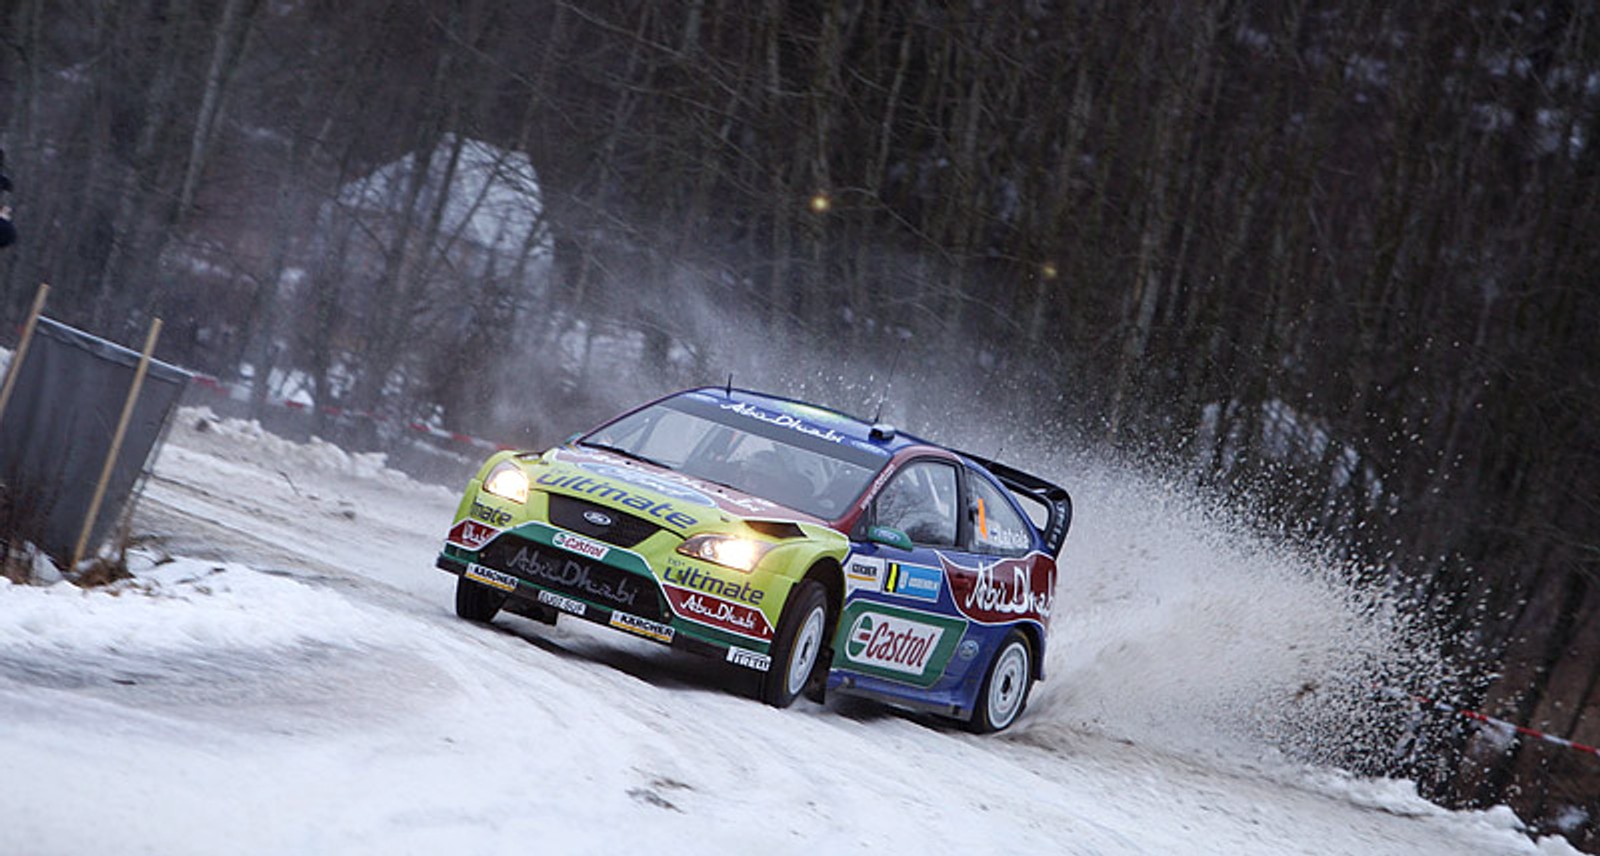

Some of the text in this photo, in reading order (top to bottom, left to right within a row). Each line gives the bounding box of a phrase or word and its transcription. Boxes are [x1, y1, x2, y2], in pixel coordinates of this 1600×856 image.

[536, 471, 698, 529] ultimate
[663, 567, 765, 605] ultimate
[866, 621, 936, 668] Castrol
